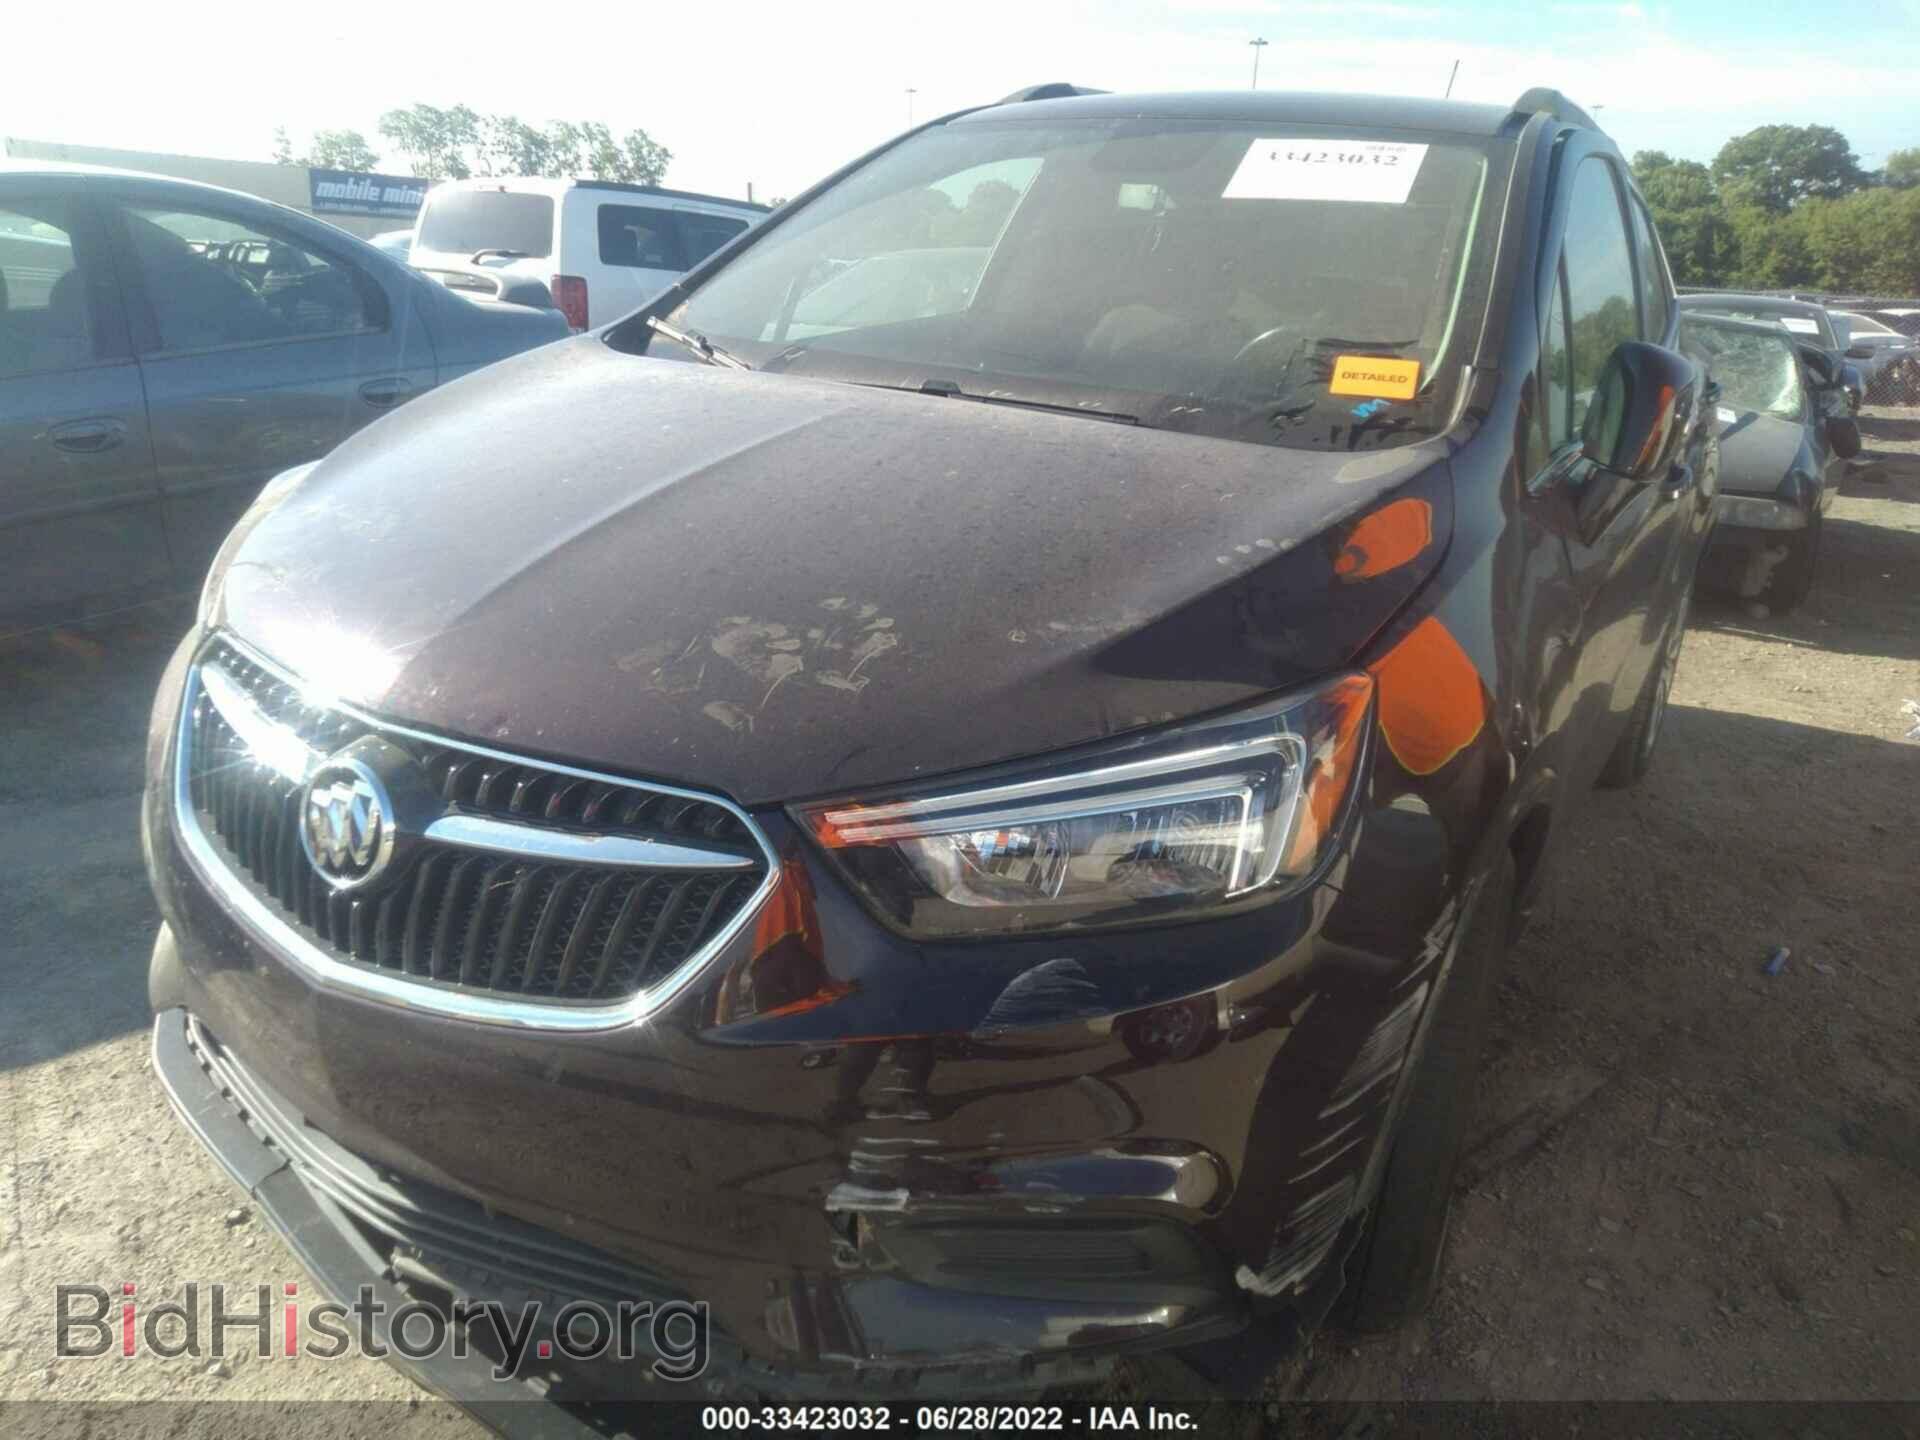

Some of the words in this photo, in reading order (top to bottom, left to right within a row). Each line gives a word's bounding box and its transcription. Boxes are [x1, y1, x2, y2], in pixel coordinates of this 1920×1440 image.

[316, 177, 381, 201] mobile
[383, 185, 424, 205] mini
[1341, 371, 1409, 384] DETAILED
